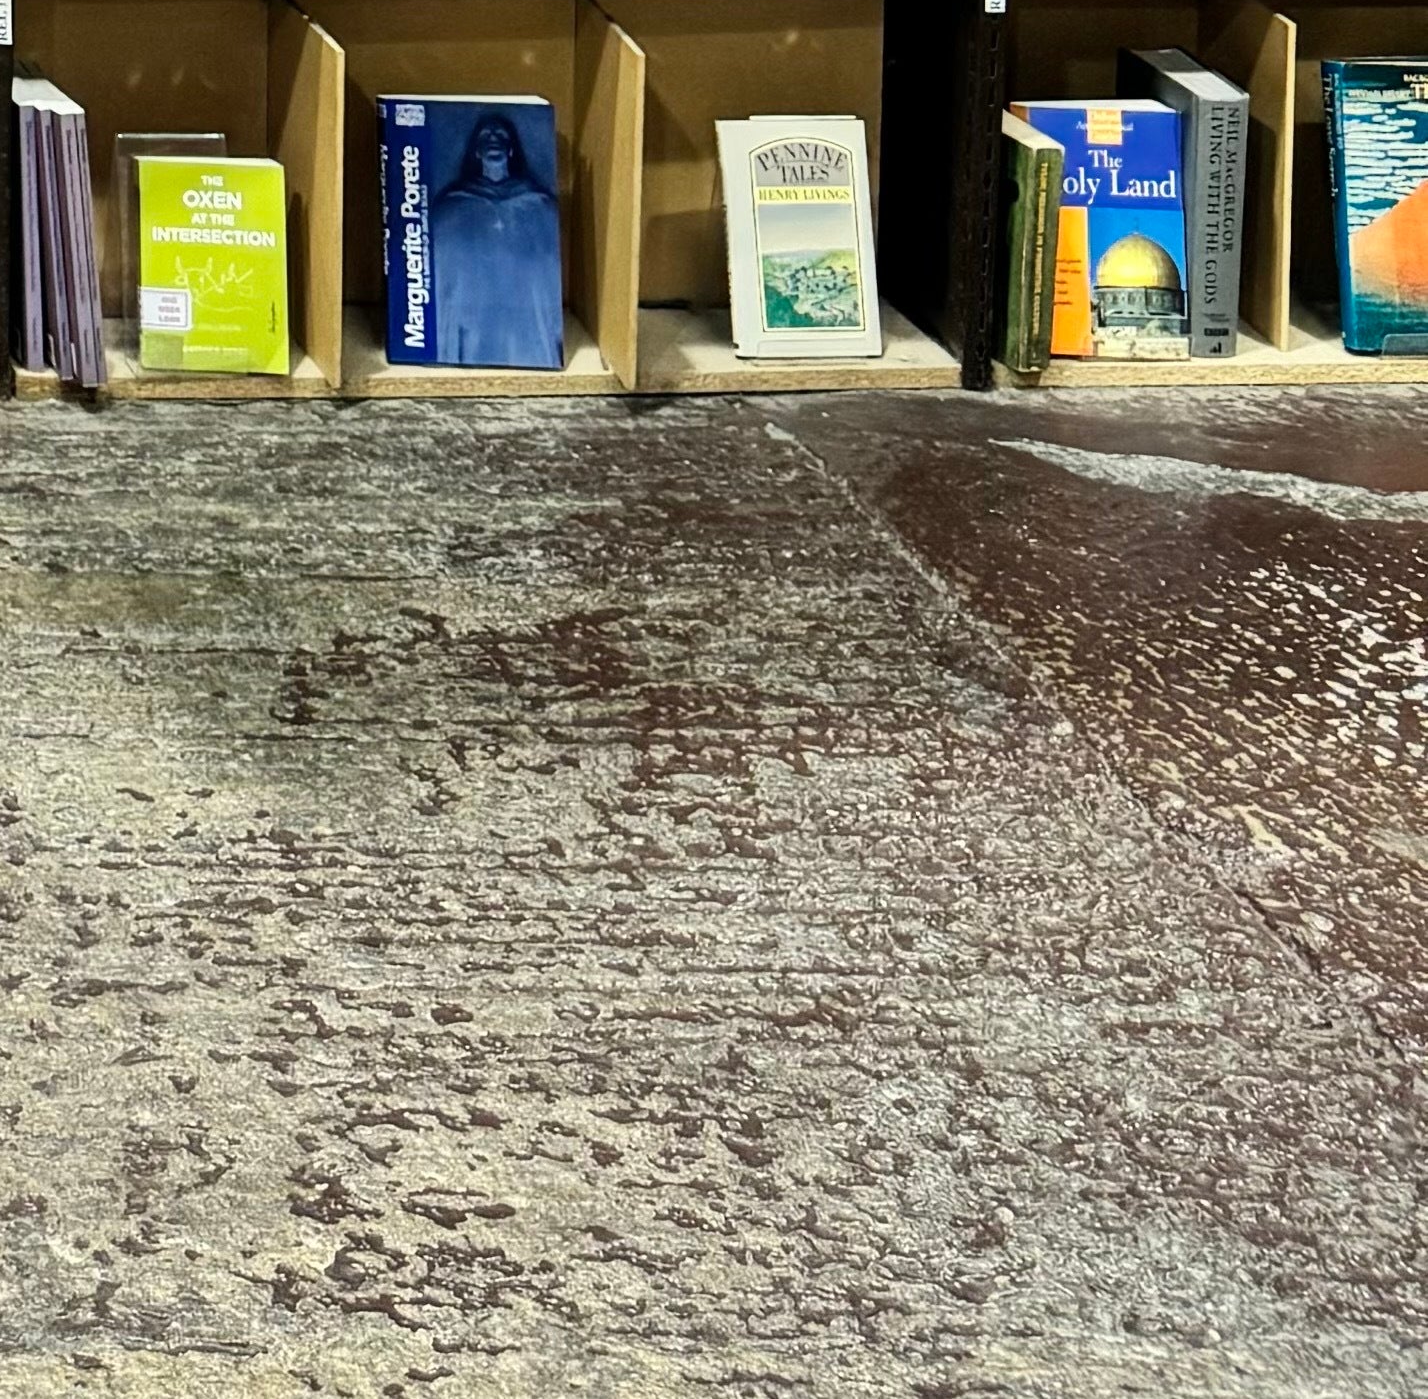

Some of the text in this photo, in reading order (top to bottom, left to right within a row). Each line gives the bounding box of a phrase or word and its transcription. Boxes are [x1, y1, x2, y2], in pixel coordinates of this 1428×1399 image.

[757, 143, 847, 174] PENNINE
[1088, 150, 1123, 169] The
[201, 175, 224, 186] THE
[776, 164, 829, 184] TALES
[1059, 168, 1177, 204] oly Land
[183, 190, 243, 209] OXEN
[1203, 107, 1224, 304] LIVING WITH THE GODS
[191, 214, 235, 227] AT THE
[152, 227, 275, 247] INTERSECTION
[401, 145, 426, 349] Marguerite Porete
